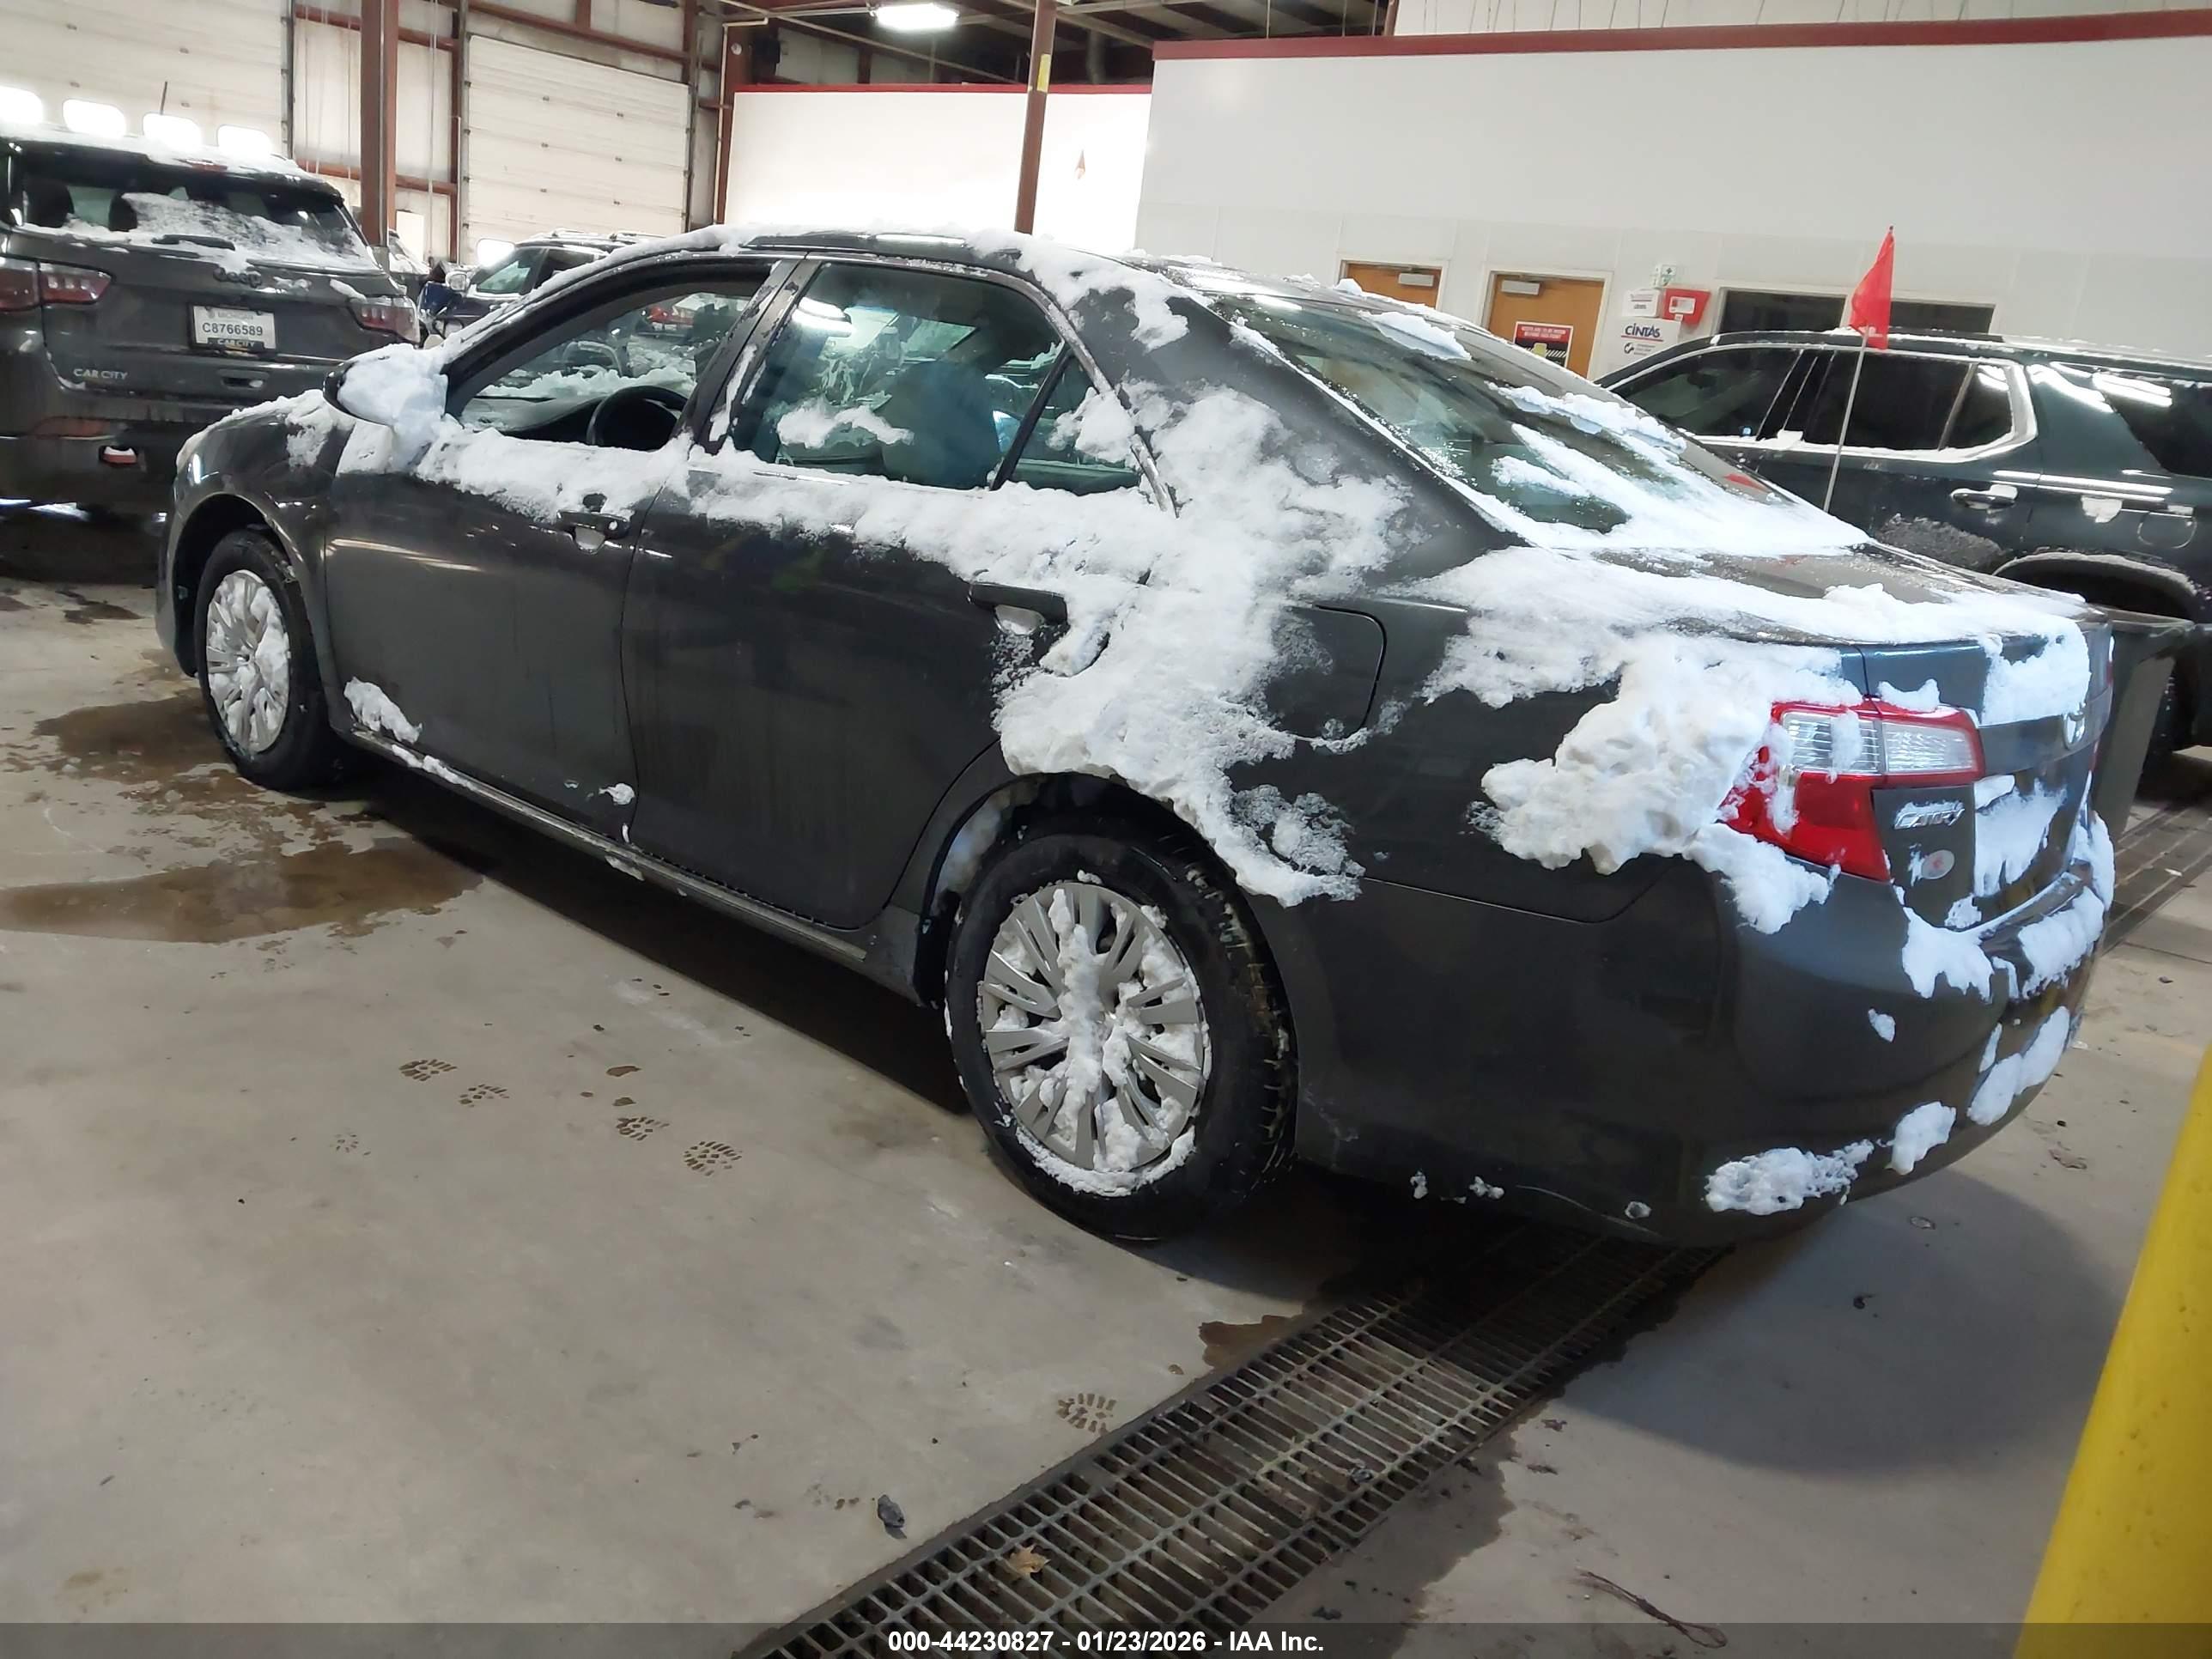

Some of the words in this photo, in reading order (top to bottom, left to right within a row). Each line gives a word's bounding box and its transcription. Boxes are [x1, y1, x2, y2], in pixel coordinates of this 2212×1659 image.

[202, 322, 263, 337] C8766589
[1625, 323, 1661, 338] CINTAS
[73, 368, 99, 379] CAR
[100, 370, 128, 380] CITY
